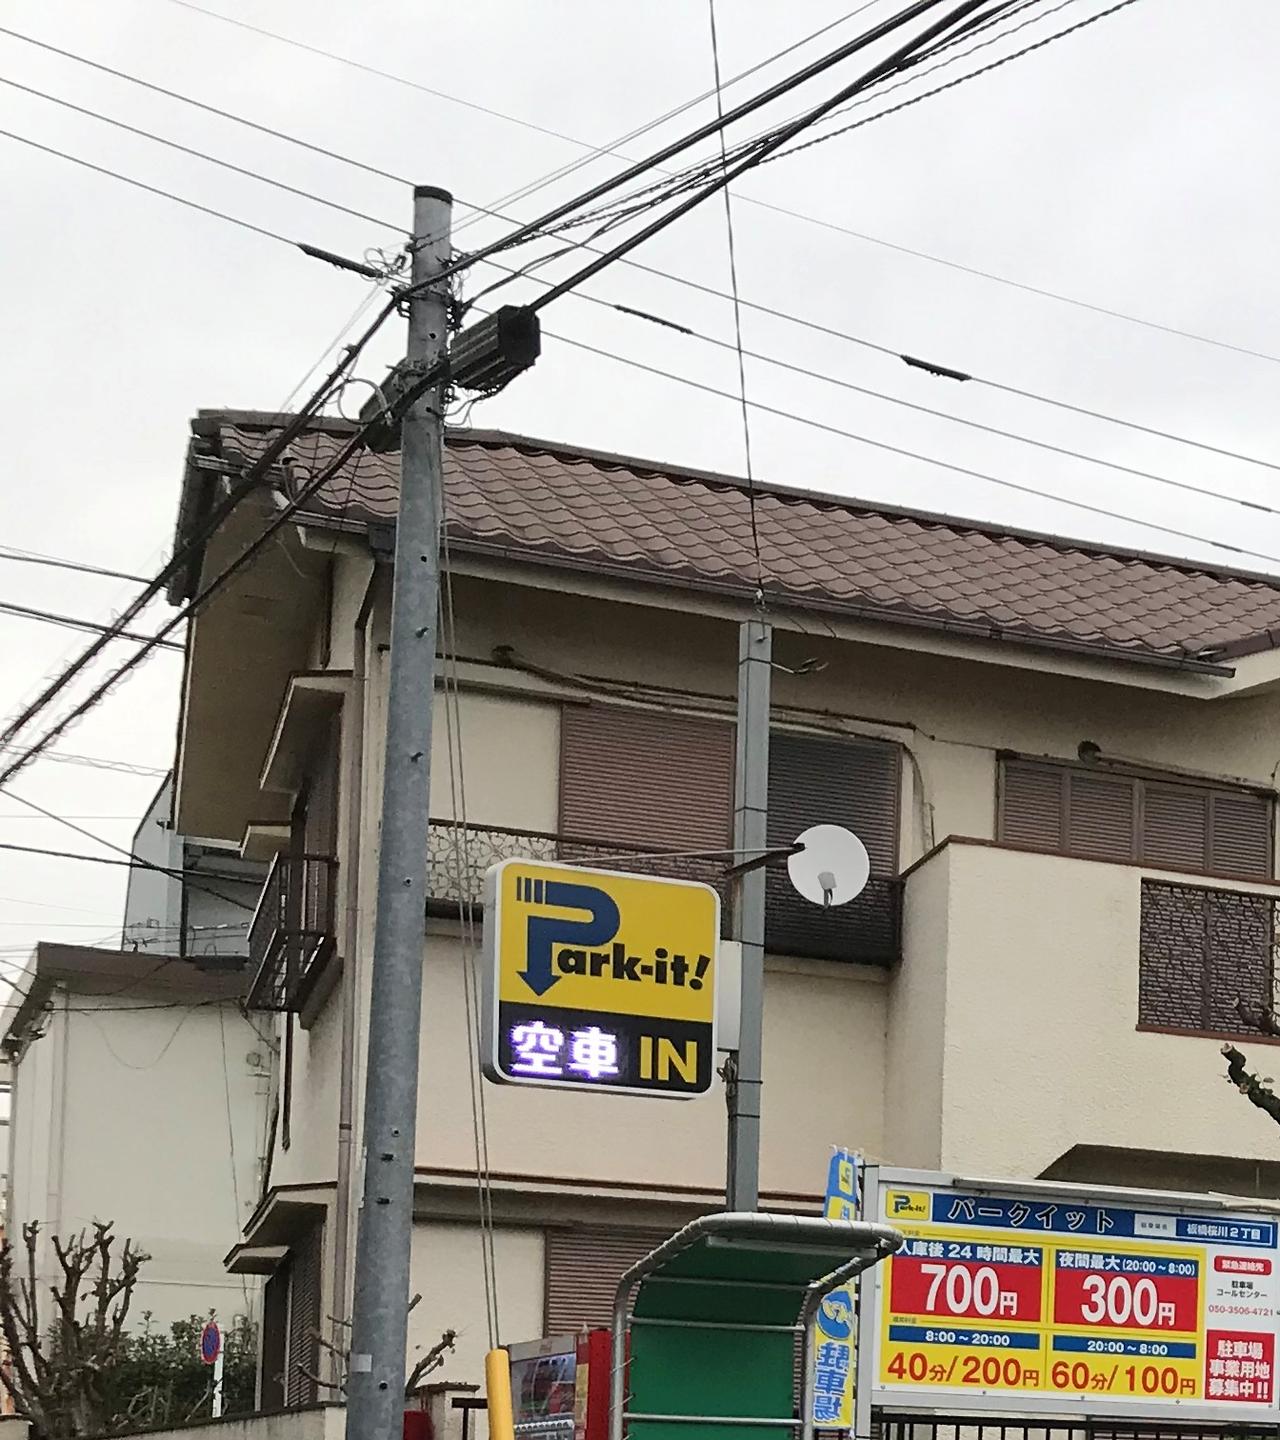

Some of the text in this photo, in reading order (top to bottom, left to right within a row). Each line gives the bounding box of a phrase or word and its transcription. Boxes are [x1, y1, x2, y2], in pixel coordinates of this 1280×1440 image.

[517, 876, 711, 997] Park-it!
[508, 1020, 619, 1080] 空車
[640, 1036, 697, 1084] IN
[948, 1198, 1114, 1233] パークイット
[920, 1263, 1018, 1316] 700円
[1080, 1274, 1176, 1326] 300円
[1216, 1288, 1268, 1299] コールセンター
[1209, 1358, 1271, 1379] 事業用地
[1217, 1339, 1264, 1360] 駐車場
